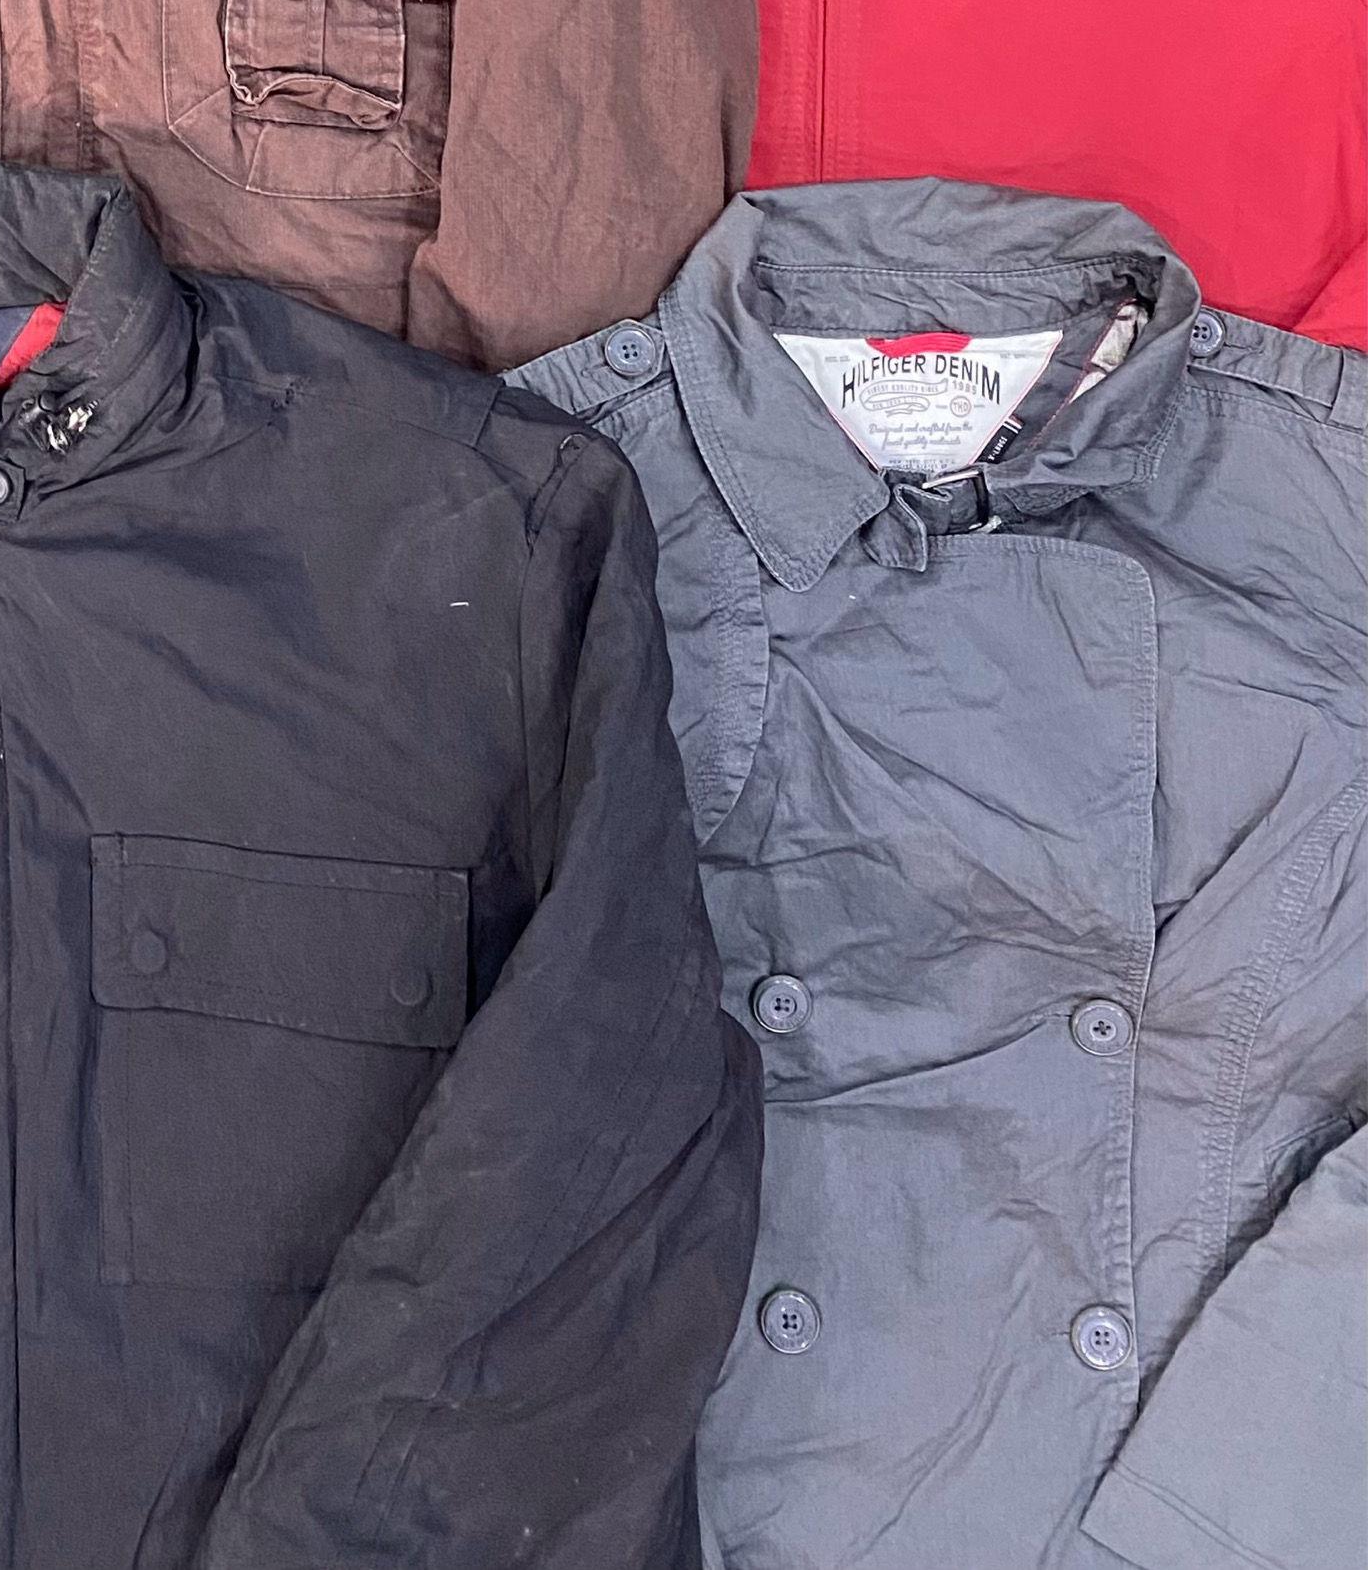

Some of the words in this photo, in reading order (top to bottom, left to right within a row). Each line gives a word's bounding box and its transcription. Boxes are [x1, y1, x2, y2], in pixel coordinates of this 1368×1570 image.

[842, 356, 926, 409] HILFIGER
[935, 354, 1000, 405] DENIM
[952, 379, 978, 396] 1985
[952, 400, 969, 413] THD
